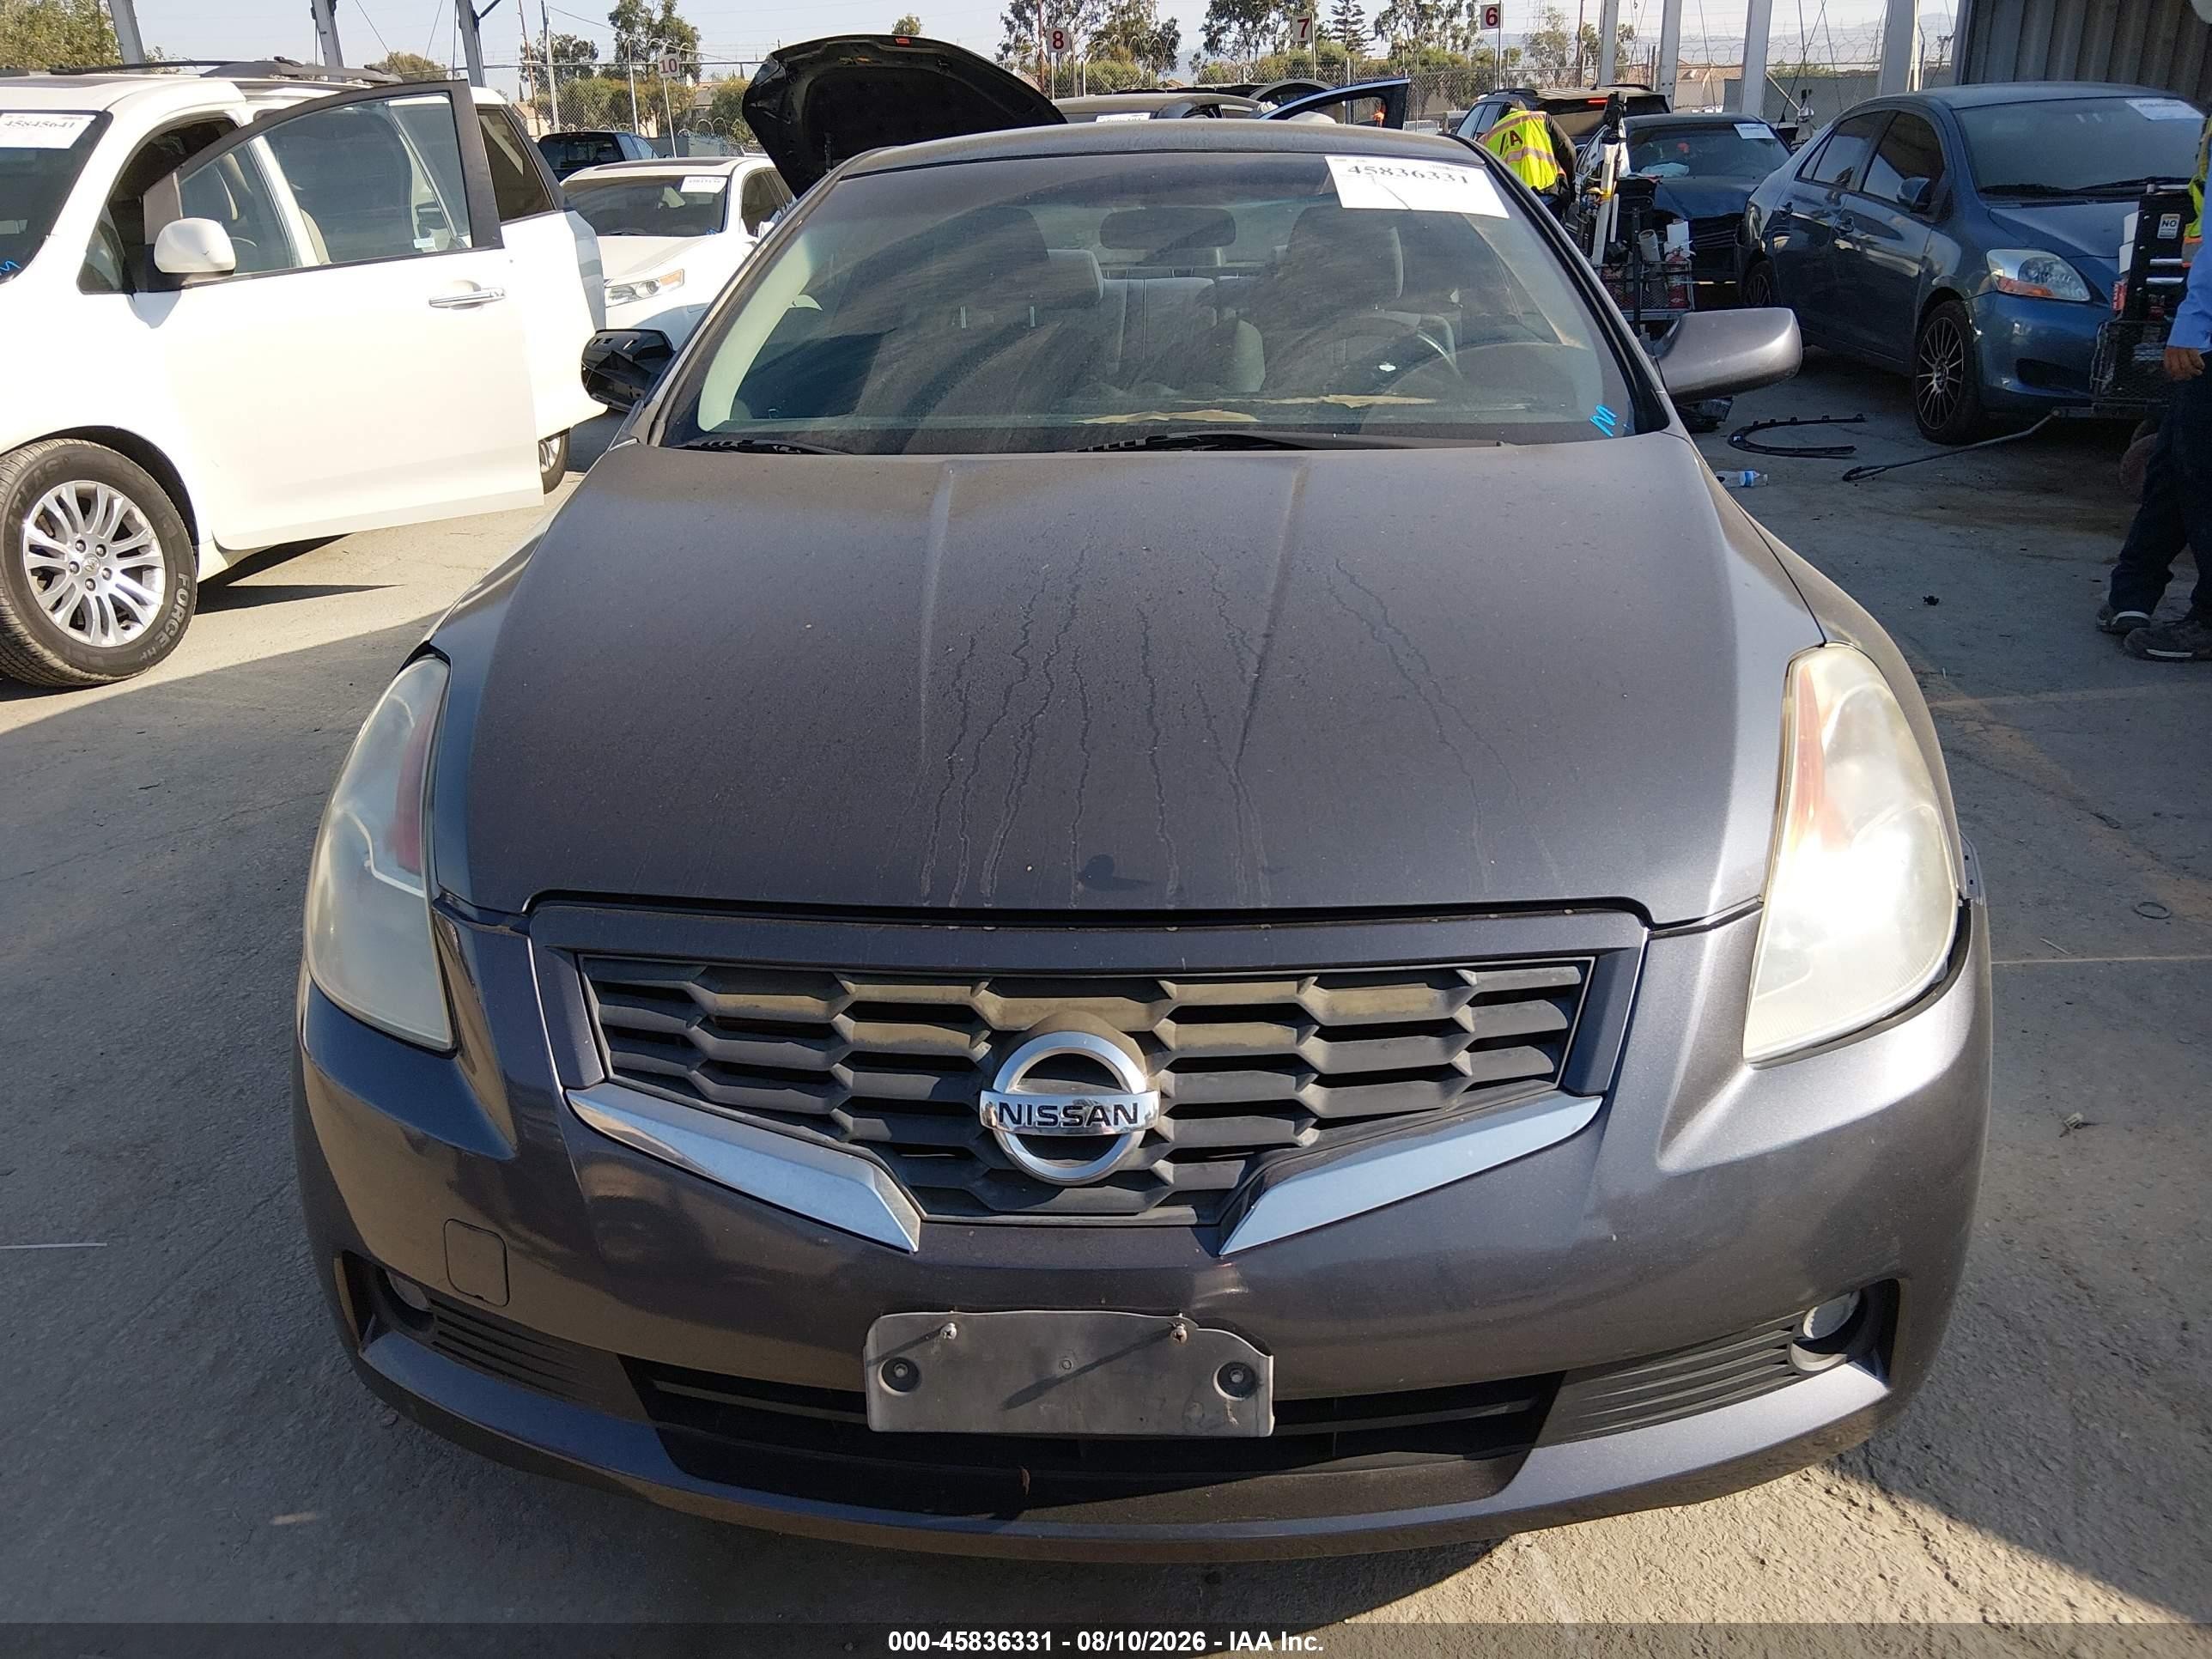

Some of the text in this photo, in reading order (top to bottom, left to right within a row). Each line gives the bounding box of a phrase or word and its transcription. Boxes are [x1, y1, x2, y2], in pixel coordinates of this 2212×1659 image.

[1486, 6, 1498, 27] 6
[1297, 18, 1310, 38] 7
[1052, 30, 1065, 50] 8
[659, 58, 678, 74] 10
[1347, 165, 1468, 184] 45836331
[155, 572, 191, 649] FORCE
[998, 1102, 1139, 1127] NISSAN
